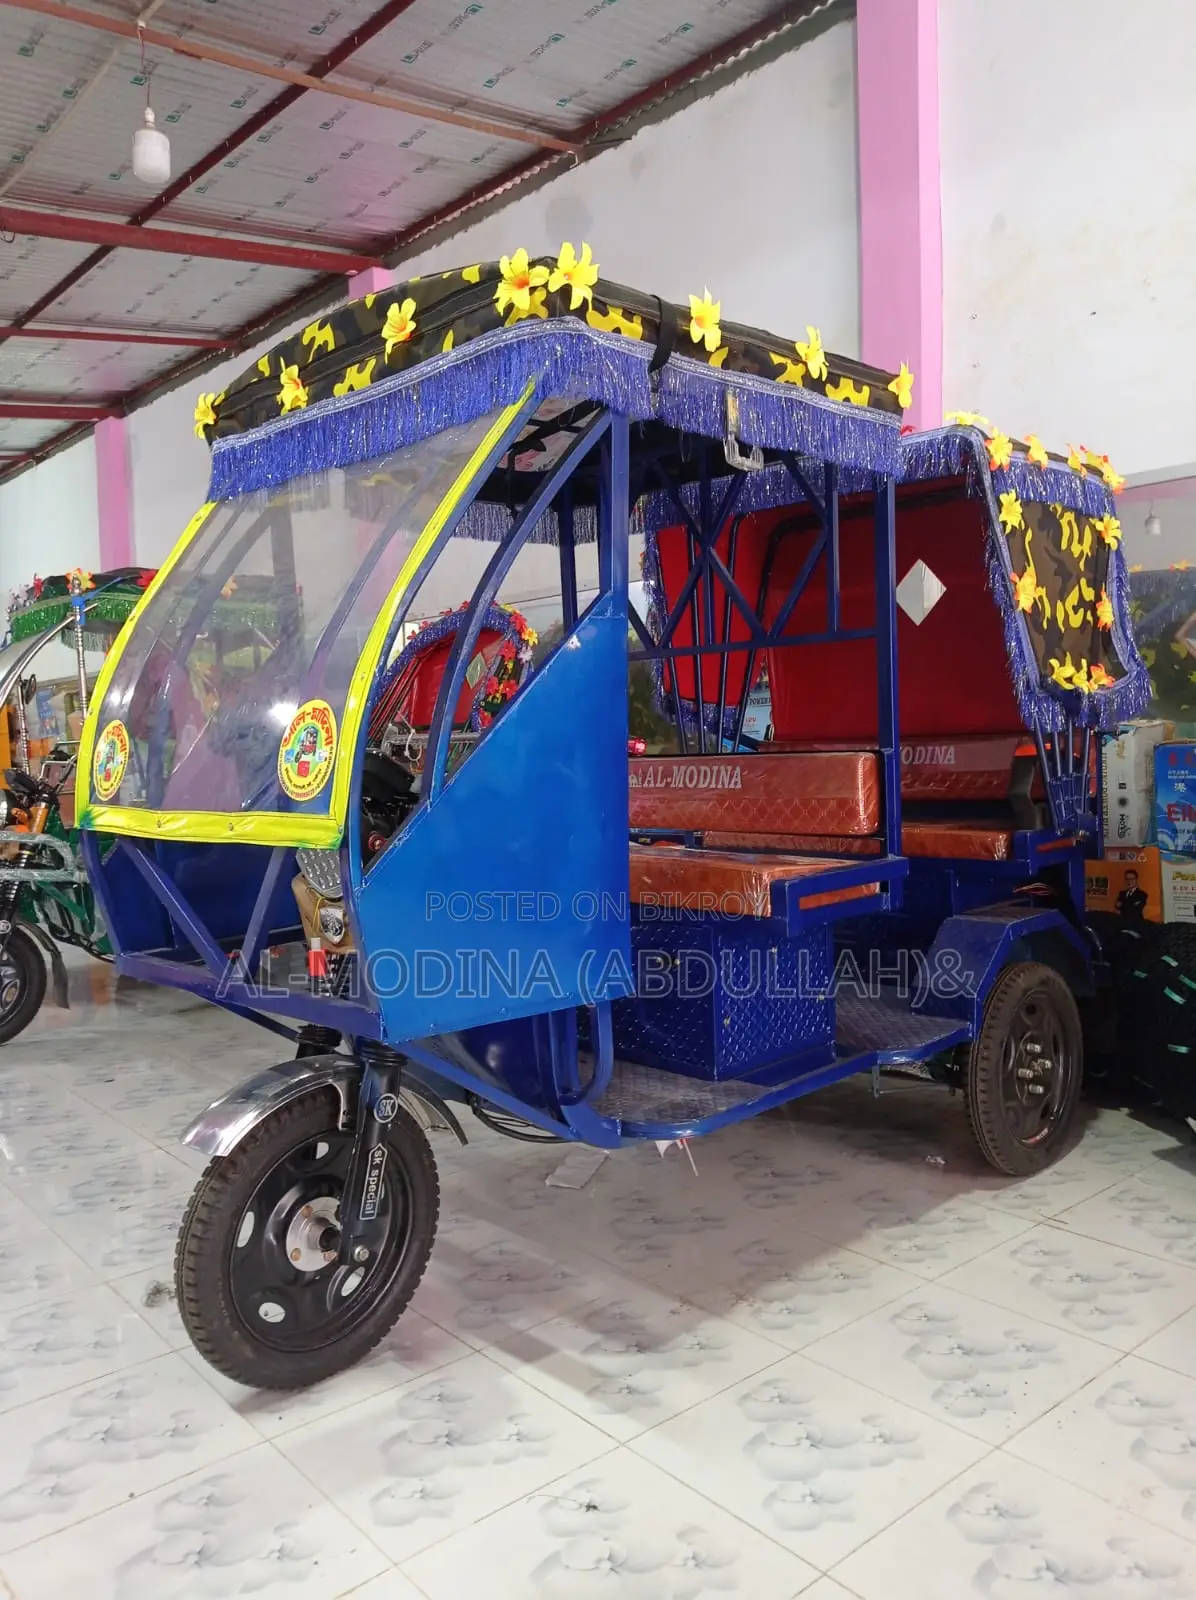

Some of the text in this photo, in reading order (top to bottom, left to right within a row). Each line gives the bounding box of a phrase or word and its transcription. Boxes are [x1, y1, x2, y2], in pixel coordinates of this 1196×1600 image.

[900, 745, 956, 765] ODINA
[643, 765, 743, 789] AL-MODINA
[378, 1099, 393, 1117] SK
[372, 1149, 383, 1165] sk
